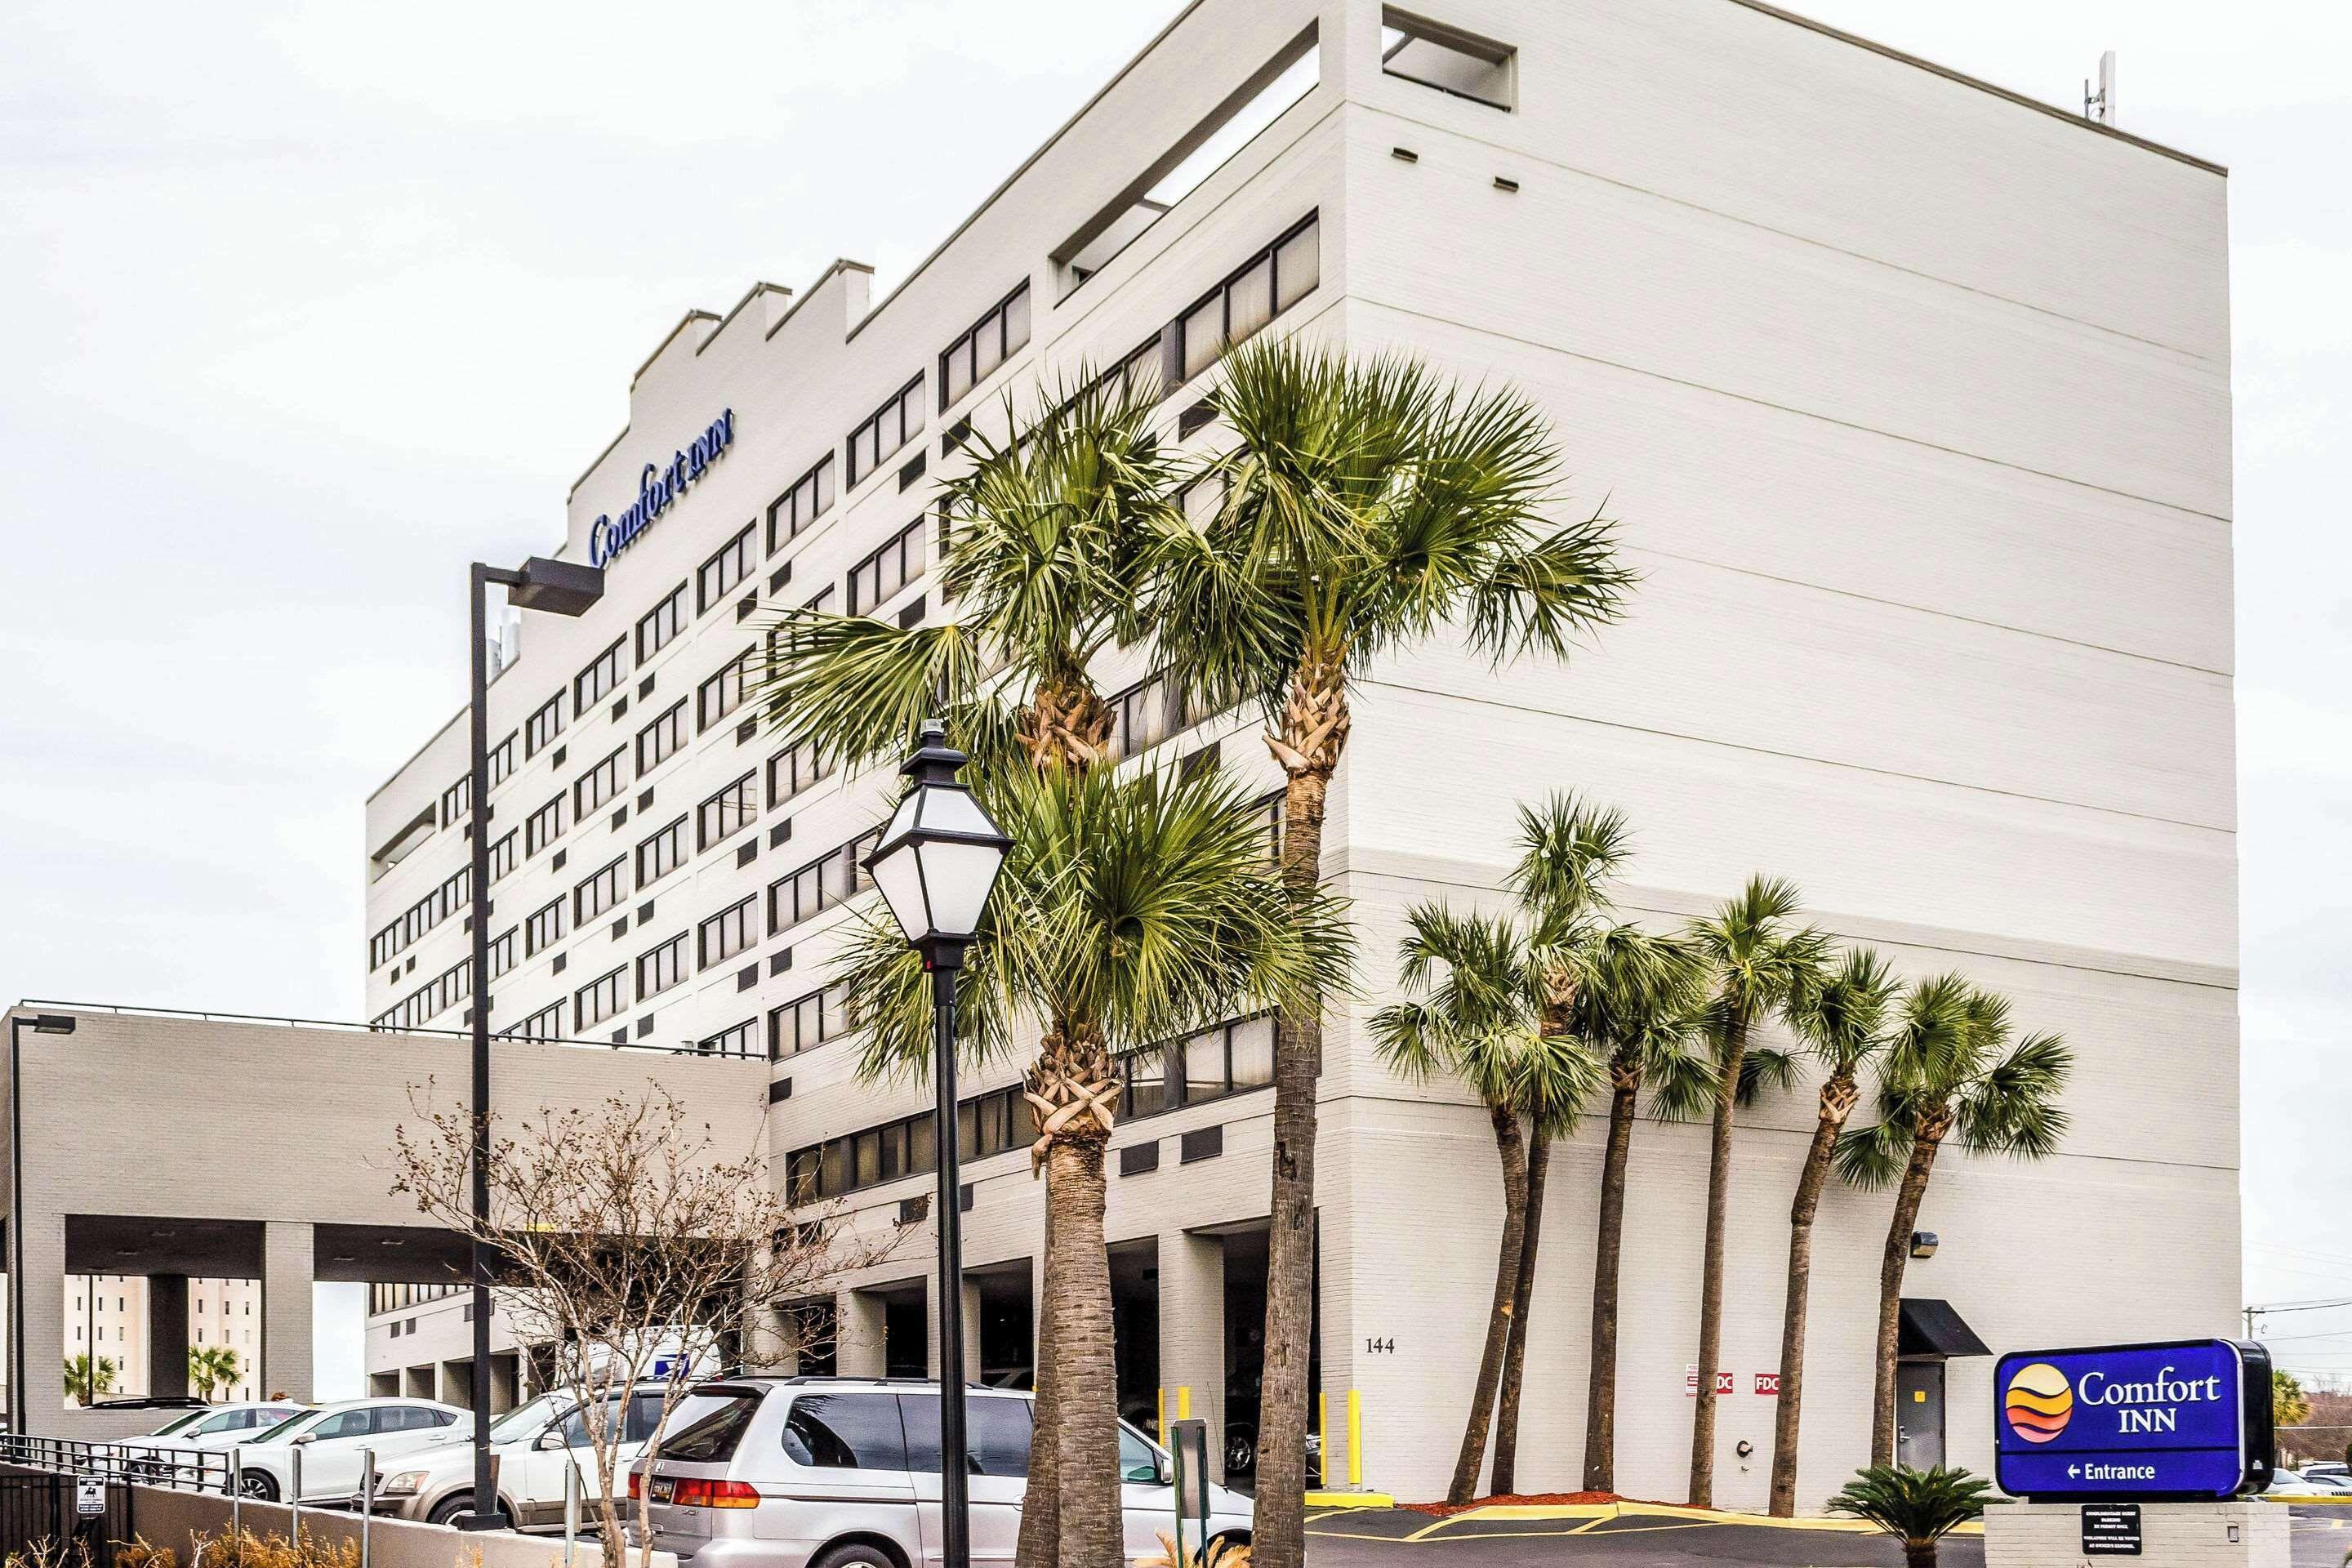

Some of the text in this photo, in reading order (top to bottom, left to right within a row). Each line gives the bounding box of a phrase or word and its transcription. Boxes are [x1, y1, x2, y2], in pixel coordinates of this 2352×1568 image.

[589, 408, 734, 568] Comfort INN
[1365, 1337, 1395, 1354] 144
[1716, 1375, 1733, 1390] DC
[1756, 1376, 1780, 1391] FDC
[2078, 1366, 2221, 1406] Comfort
[2118, 1408, 2177, 1433] INN
[2085, 1463, 2155, 1480] Entrance
